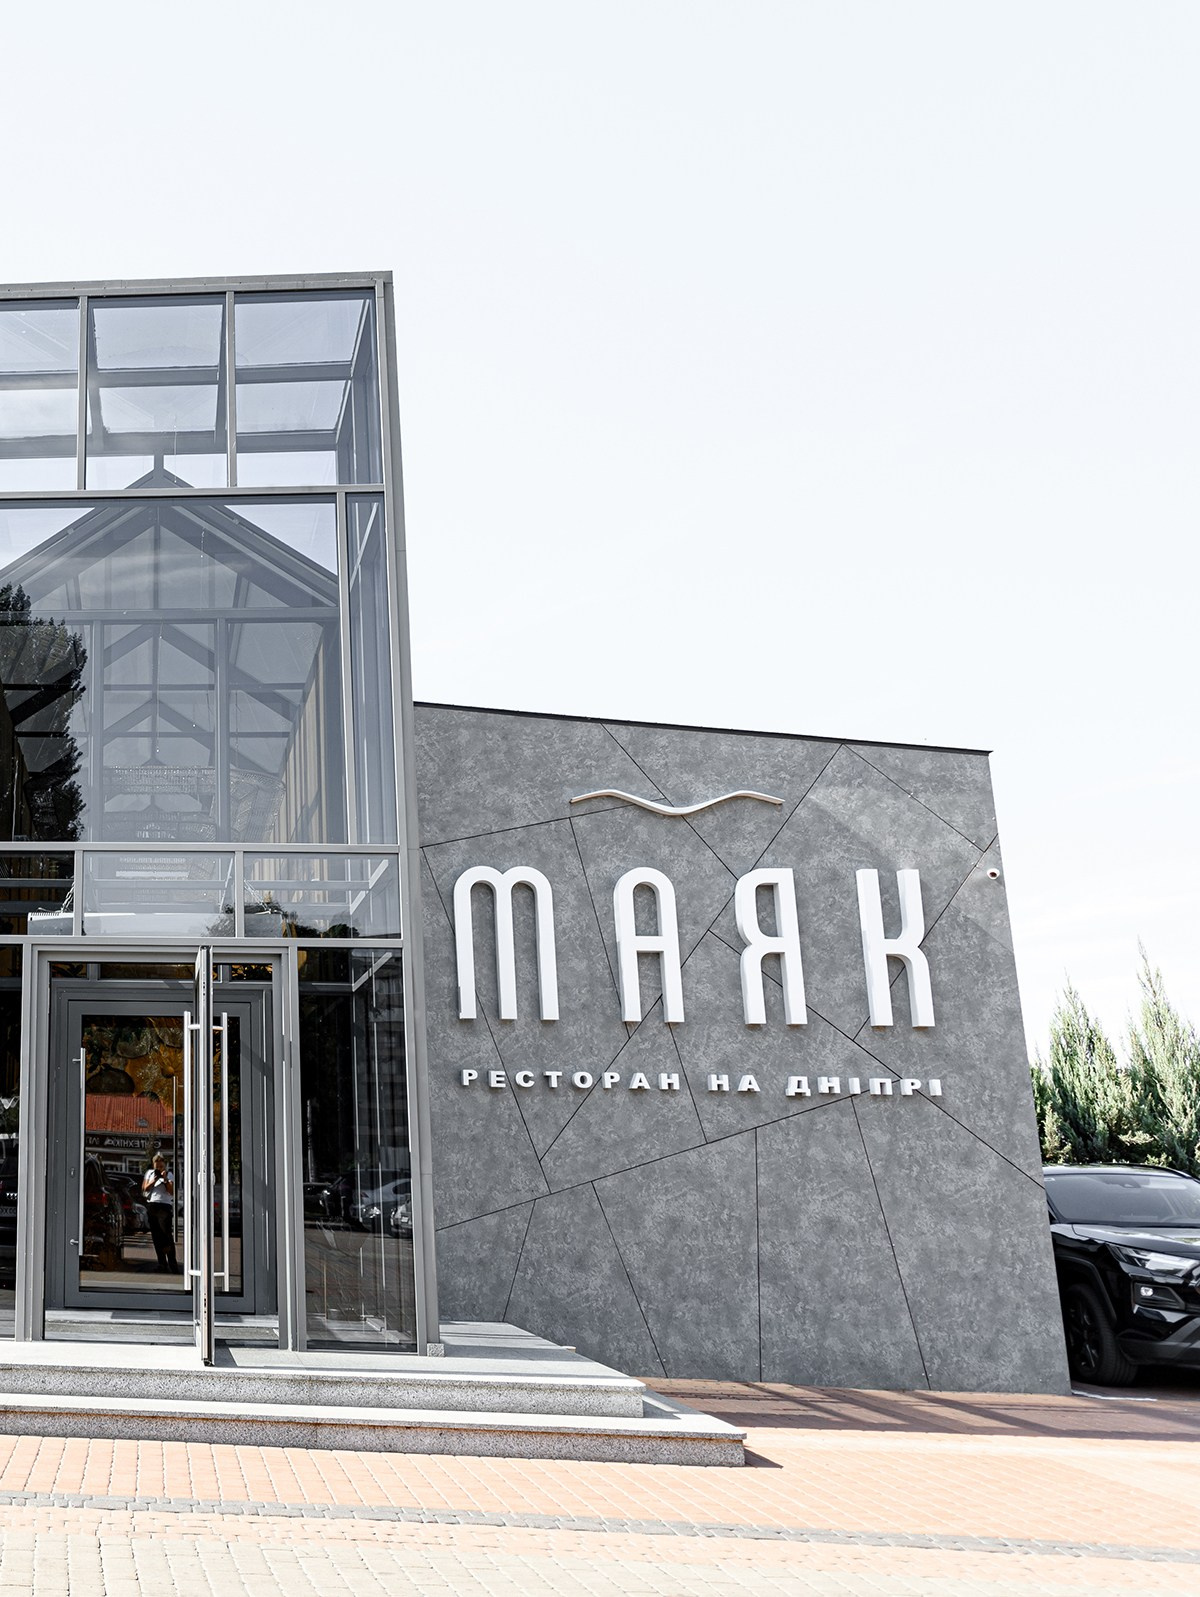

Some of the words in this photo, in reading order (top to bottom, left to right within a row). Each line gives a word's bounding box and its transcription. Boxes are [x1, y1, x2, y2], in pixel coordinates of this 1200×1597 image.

[454, 866, 935, 1028] МАЯК
[461, 1069, 680, 1090] РЕСТОРАН
[707, 1074, 761, 1092] НА
[785, 1076, 943, 1096] ДНІПРІ
